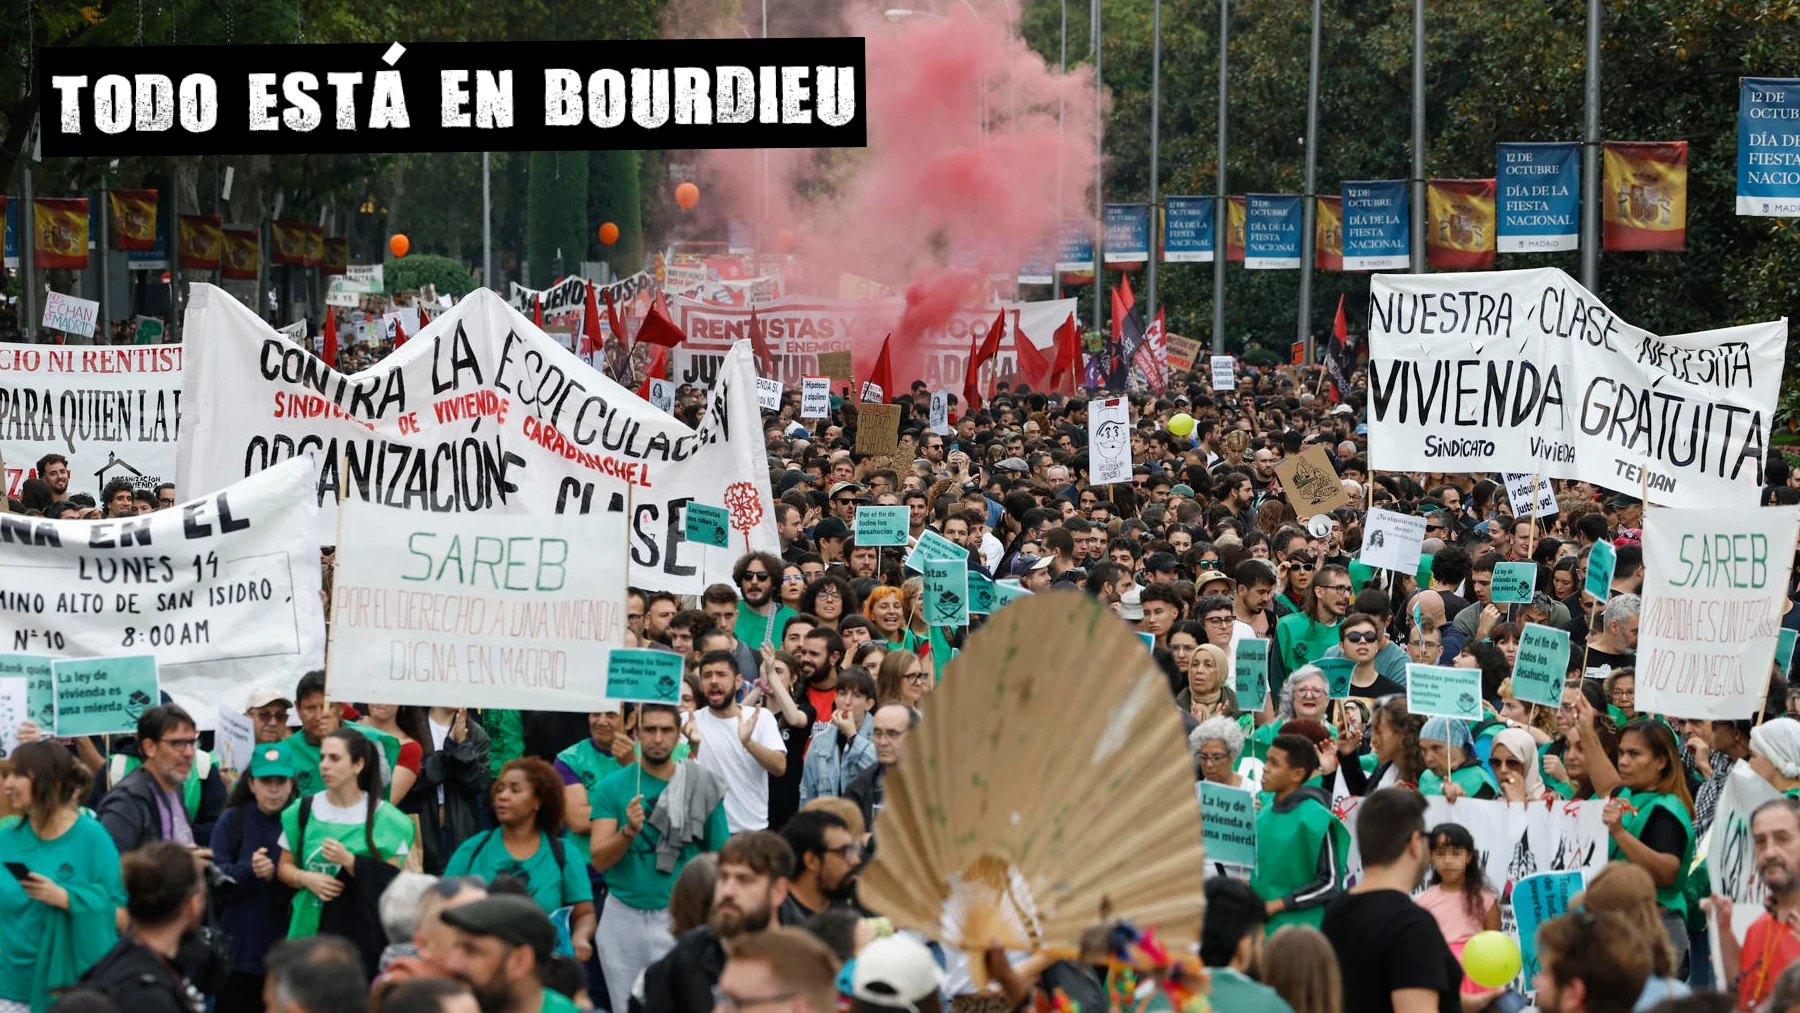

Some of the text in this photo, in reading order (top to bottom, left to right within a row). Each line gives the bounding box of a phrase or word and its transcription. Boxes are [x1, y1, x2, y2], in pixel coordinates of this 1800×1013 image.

[1751, 92, 1785, 103] 12 DE
[1750, 108, 1800, 119] OCTUB
[1749, 132, 1778, 147] DÍA
[1506, 153, 1532, 162] 12 DE
[1748, 153, 1800, 166] FIESTA
[1506, 165, 1559, 174] OCTUBRE
[1358, 189, 1370, 197] DE
[1506, 184, 1569, 197] DÍA DE LA
[1348, 199, 1392, 207] OCTUBRE
[1506, 201, 1549, 211] FIESTA
[1251, 208, 1288, 216] OCTUBRE
[1251, 222, 1295, 231] DÍA DE LA
[1350, 215, 1400, 225] DÍA DE LA
[1506, 216, 1574, 226] NACIONAL
[1251, 233, 1280, 241] FIESTA
[1350, 228, 1384, 237] FIESTA
[1350, 240, 1404, 249] NACIONAL
[48, 302, 93, 322] ECHAN
[52, 315, 94, 336] MADRID
[1369, 287, 1752, 388] NUESTRA CLASE NECESITA
[48, 350, 75, 372] NI
[260, 339, 406, 419] CONTRA
[432, 319, 483, 395] LA
[60, 389, 133, 454] QUIEN
[138, 389, 170, 442] LA
[1370, 359, 1564, 431] VIVIENDA
[1581, 377, 1763, 487] GRATUITA
[398, 412, 420, 436] DE
[523, 415, 652, 487] CARABANCHEL
[1512, 490, 1517, 500] y
[1540, 494, 1552, 510] ya!
[89, 519, 152, 548] EN
[183, 491, 250, 540] EL
[79, 551, 218, 583] LUNES 14
[401, 532, 568, 591] SAREB
[1669, 533, 1768, 588] SAREB
[934, 583, 943, 592] la
[57, 593, 104, 613] ALTO
[116, 593, 141, 614] DE
[157, 590, 193, 611] SAN
[335, 587, 621, 642] POR EL DERECHO A UNA VIVIENDA
[1697, 600, 1720, 642] ES
[1720, 600, 1739, 643] UN
[1524, 634, 1559, 650] Por el fin de
[389, 640, 567, 690] DIGNA EN MADRID
[1520, 651, 1547, 665] todos los
[58, 671, 108, 684] La ley de
[1517, 668, 1549, 683] desahucios
[1644, 648, 1698, 694] NO UN
[59, 686, 121, 699] vivienda es
[1412, 682, 1428, 690] fuera
[59, 702, 123, 715] una mierda
[1203, 794, 1246, 812] La ley de
[1201, 812, 1243, 828] vivienda
[1544, 877, 1553, 891] de
